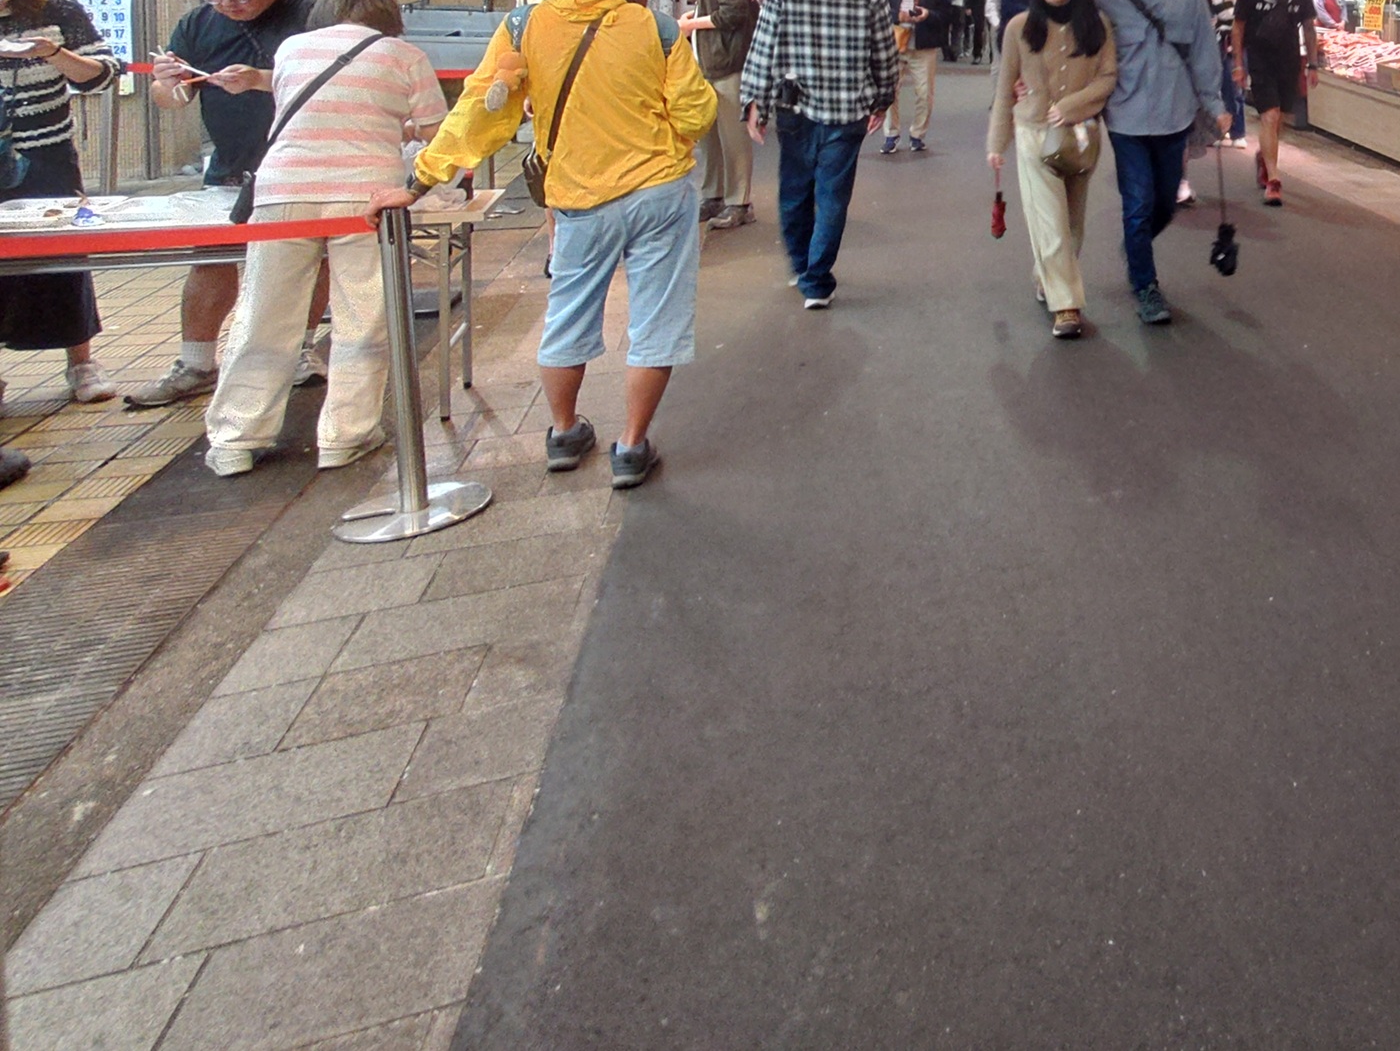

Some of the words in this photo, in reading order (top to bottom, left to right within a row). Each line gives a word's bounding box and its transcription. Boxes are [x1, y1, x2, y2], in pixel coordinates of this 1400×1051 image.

[102, 12, 108, 21] 9
[114, 12, 125, 21] 10
[114, 29, 125, 38] 17
[113, 45, 127, 55] 24
